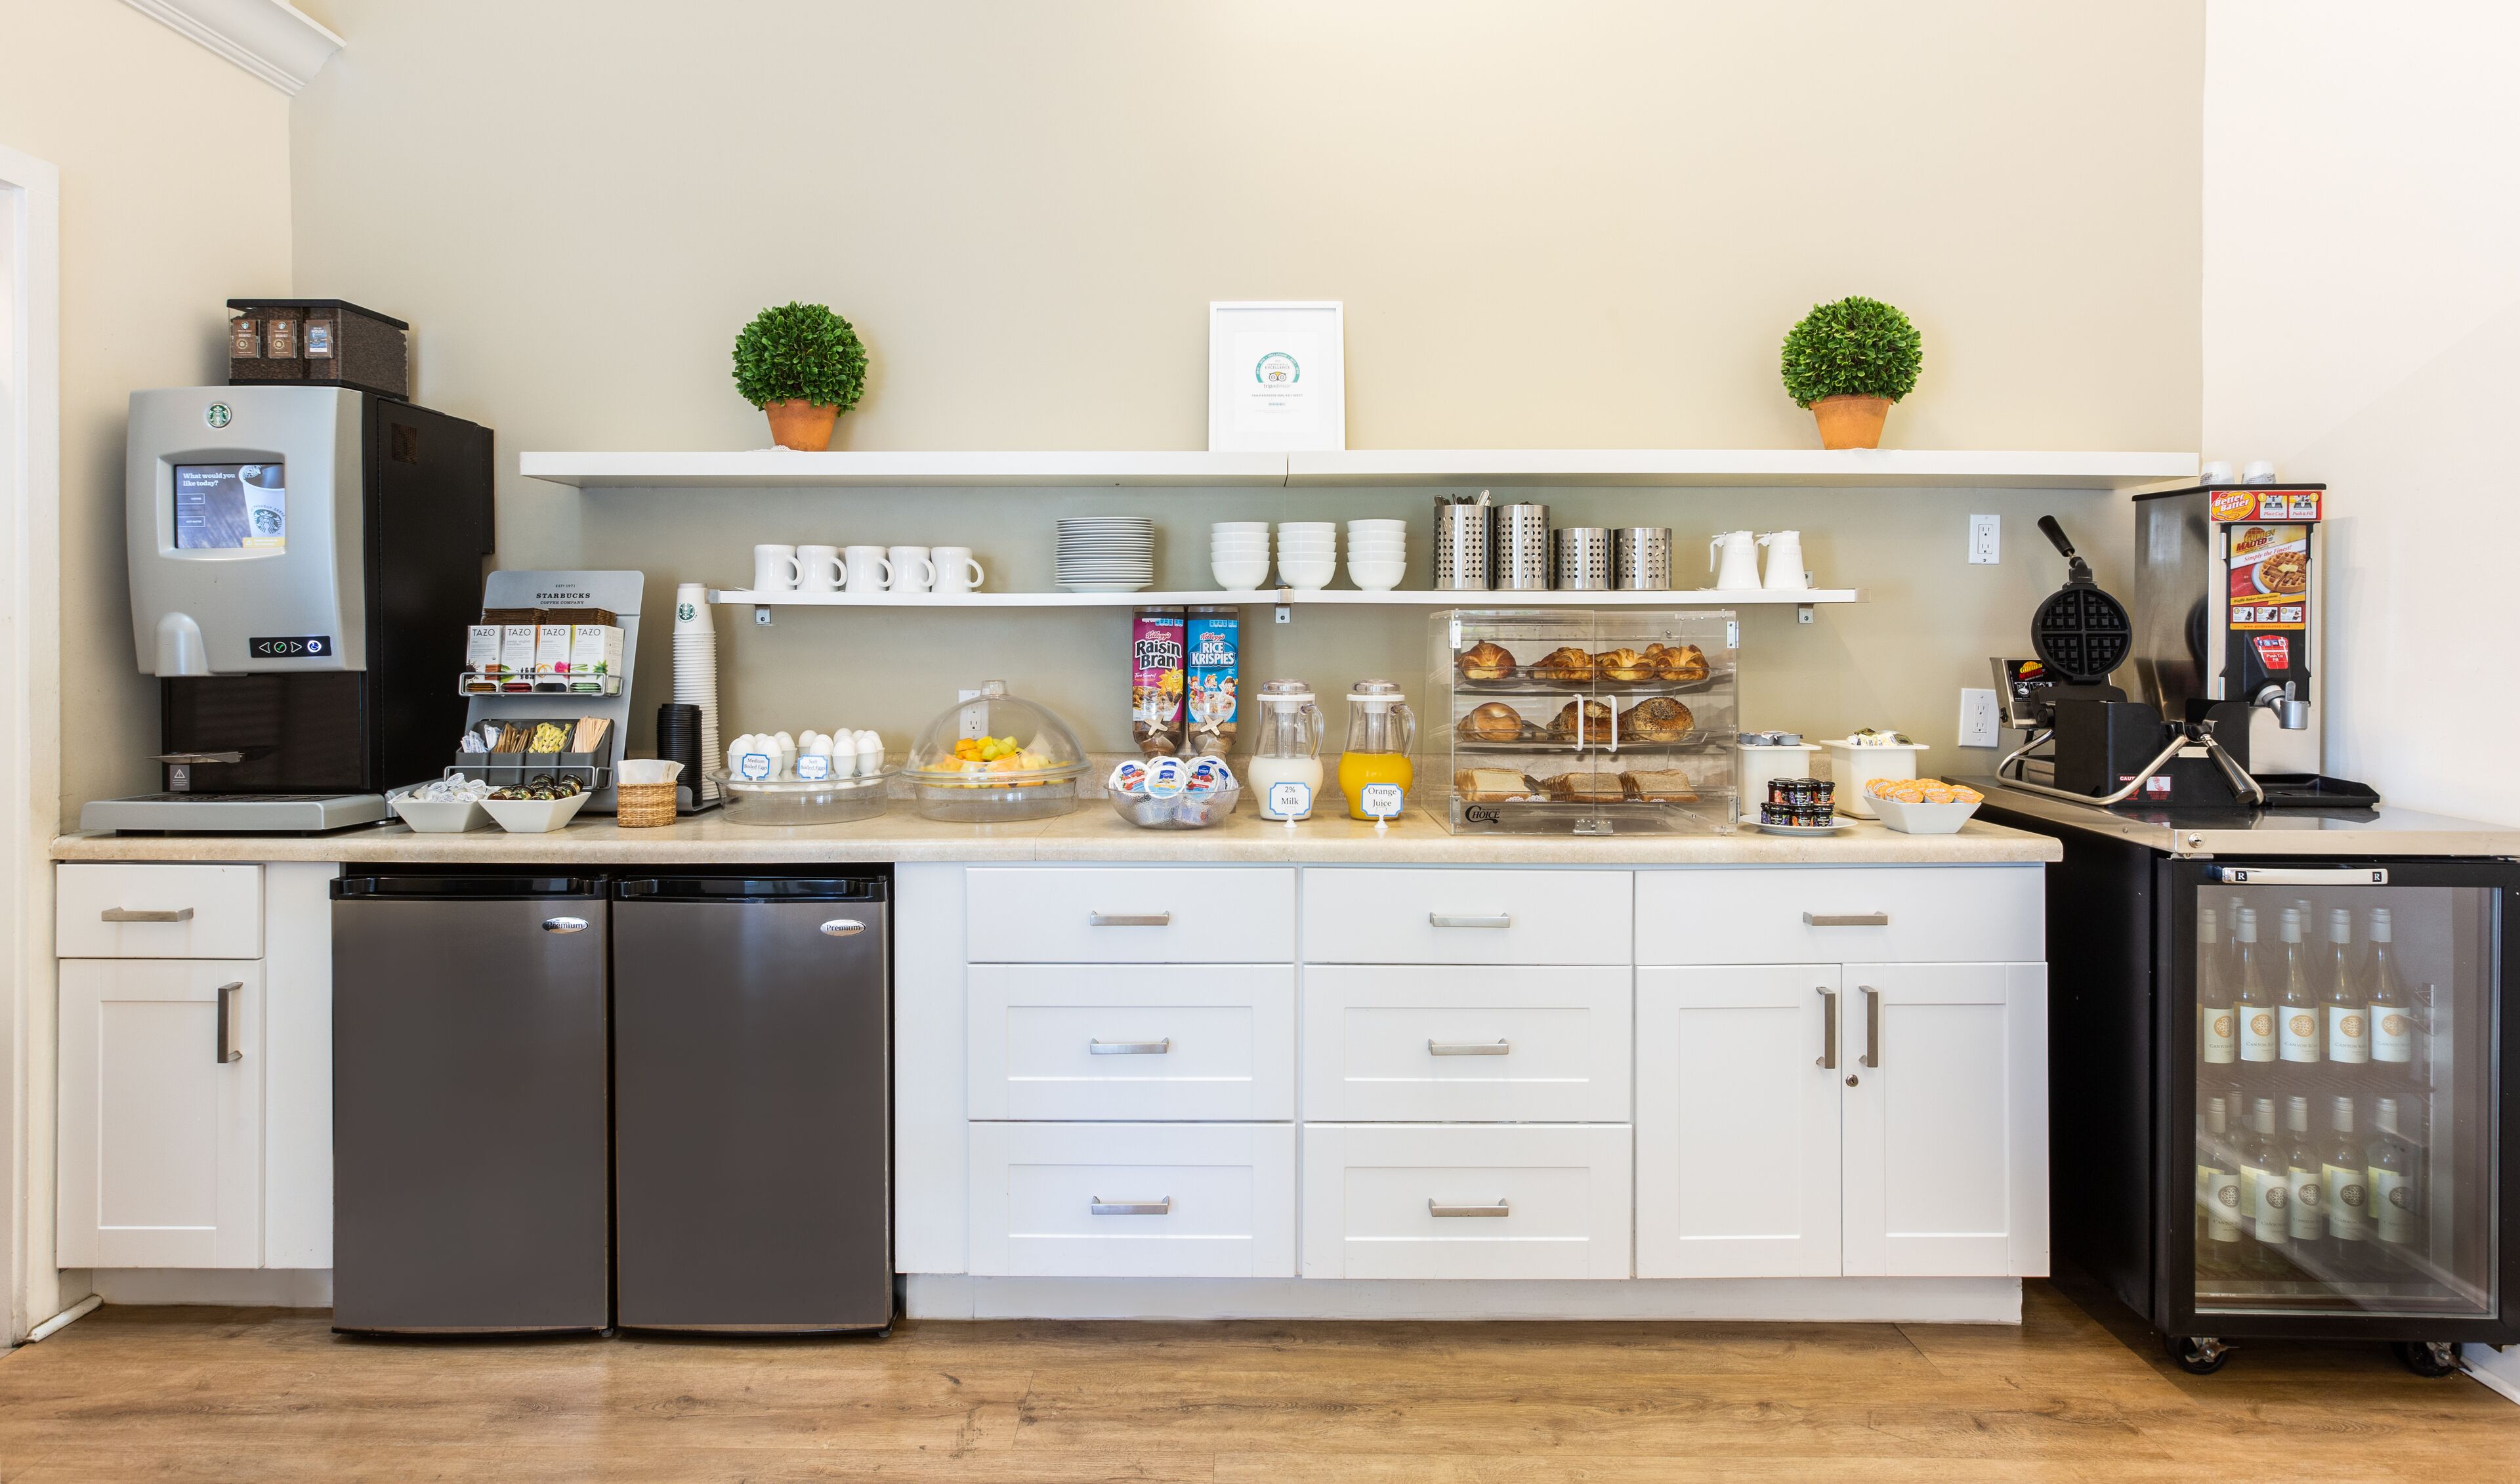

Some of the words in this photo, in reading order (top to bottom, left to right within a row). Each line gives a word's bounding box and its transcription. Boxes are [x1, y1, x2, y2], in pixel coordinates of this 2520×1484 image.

[2215, 494, 2244, 507] Better
[2220, 499, 2250, 512] Batter
[2236, 538, 2267, 551] MALTED
[2244, 553, 2263, 562] Simply
[2273, 545, 2292, 554] Finest!
[1145, 630, 1171, 641] Kellogg's
[1200, 631, 1225, 641] Kellogg's
[1135, 640, 1181, 657] Raisin
[1202, 643, 1224, 653] RICE
[1141, 654, 1177, 669] Bran
[1192, 652, 1234, 665] KRISPIES
[1368, 787, 1396, 796] Orange
[1465, 805, 1500, 824] CHOICE
